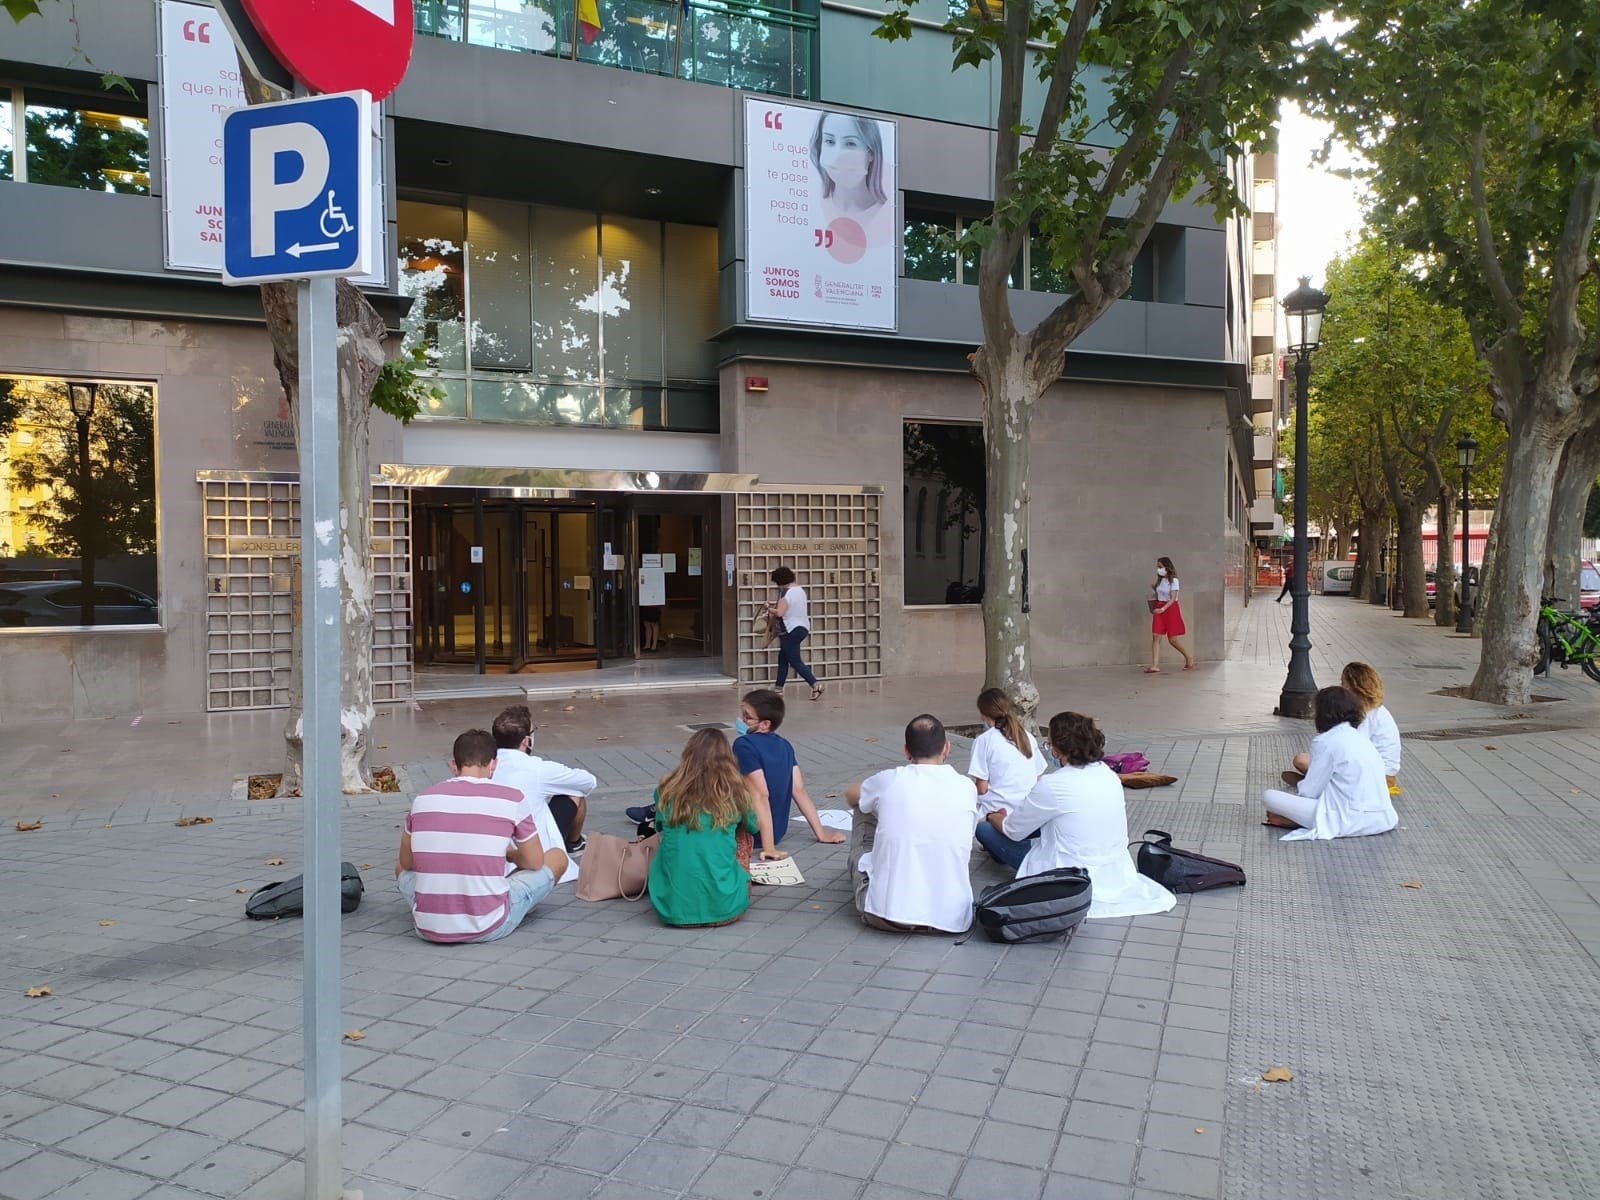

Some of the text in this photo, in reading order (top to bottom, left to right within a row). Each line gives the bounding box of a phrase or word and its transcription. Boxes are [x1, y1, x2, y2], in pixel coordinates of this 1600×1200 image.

[182, 82, 214, 96] que
[219, 84, 232, 98] hi
[772, 141, 809, 156] Lo que
[791, 158, 809, 169] a ti
[767, 169, 809, 184] te pase
[250, 122, 330, 258] P
[789, 187, 809, 198] nos
[195, 204, 222, 216] JUN
[770, 200, 799, 211] pasa
[207, 219, 223, 230] SO
[777, 212, 809, 226] todos
[200, 231, 222, 243] SAL
[763, 266, 800, 278] JUNTOS
[765, 277, 800, 288] SOMOS
[769, 288, 800, 299] SALUD
[815, 543, 824, 551] DE
[830, 543, 858, 551] SANITAT
